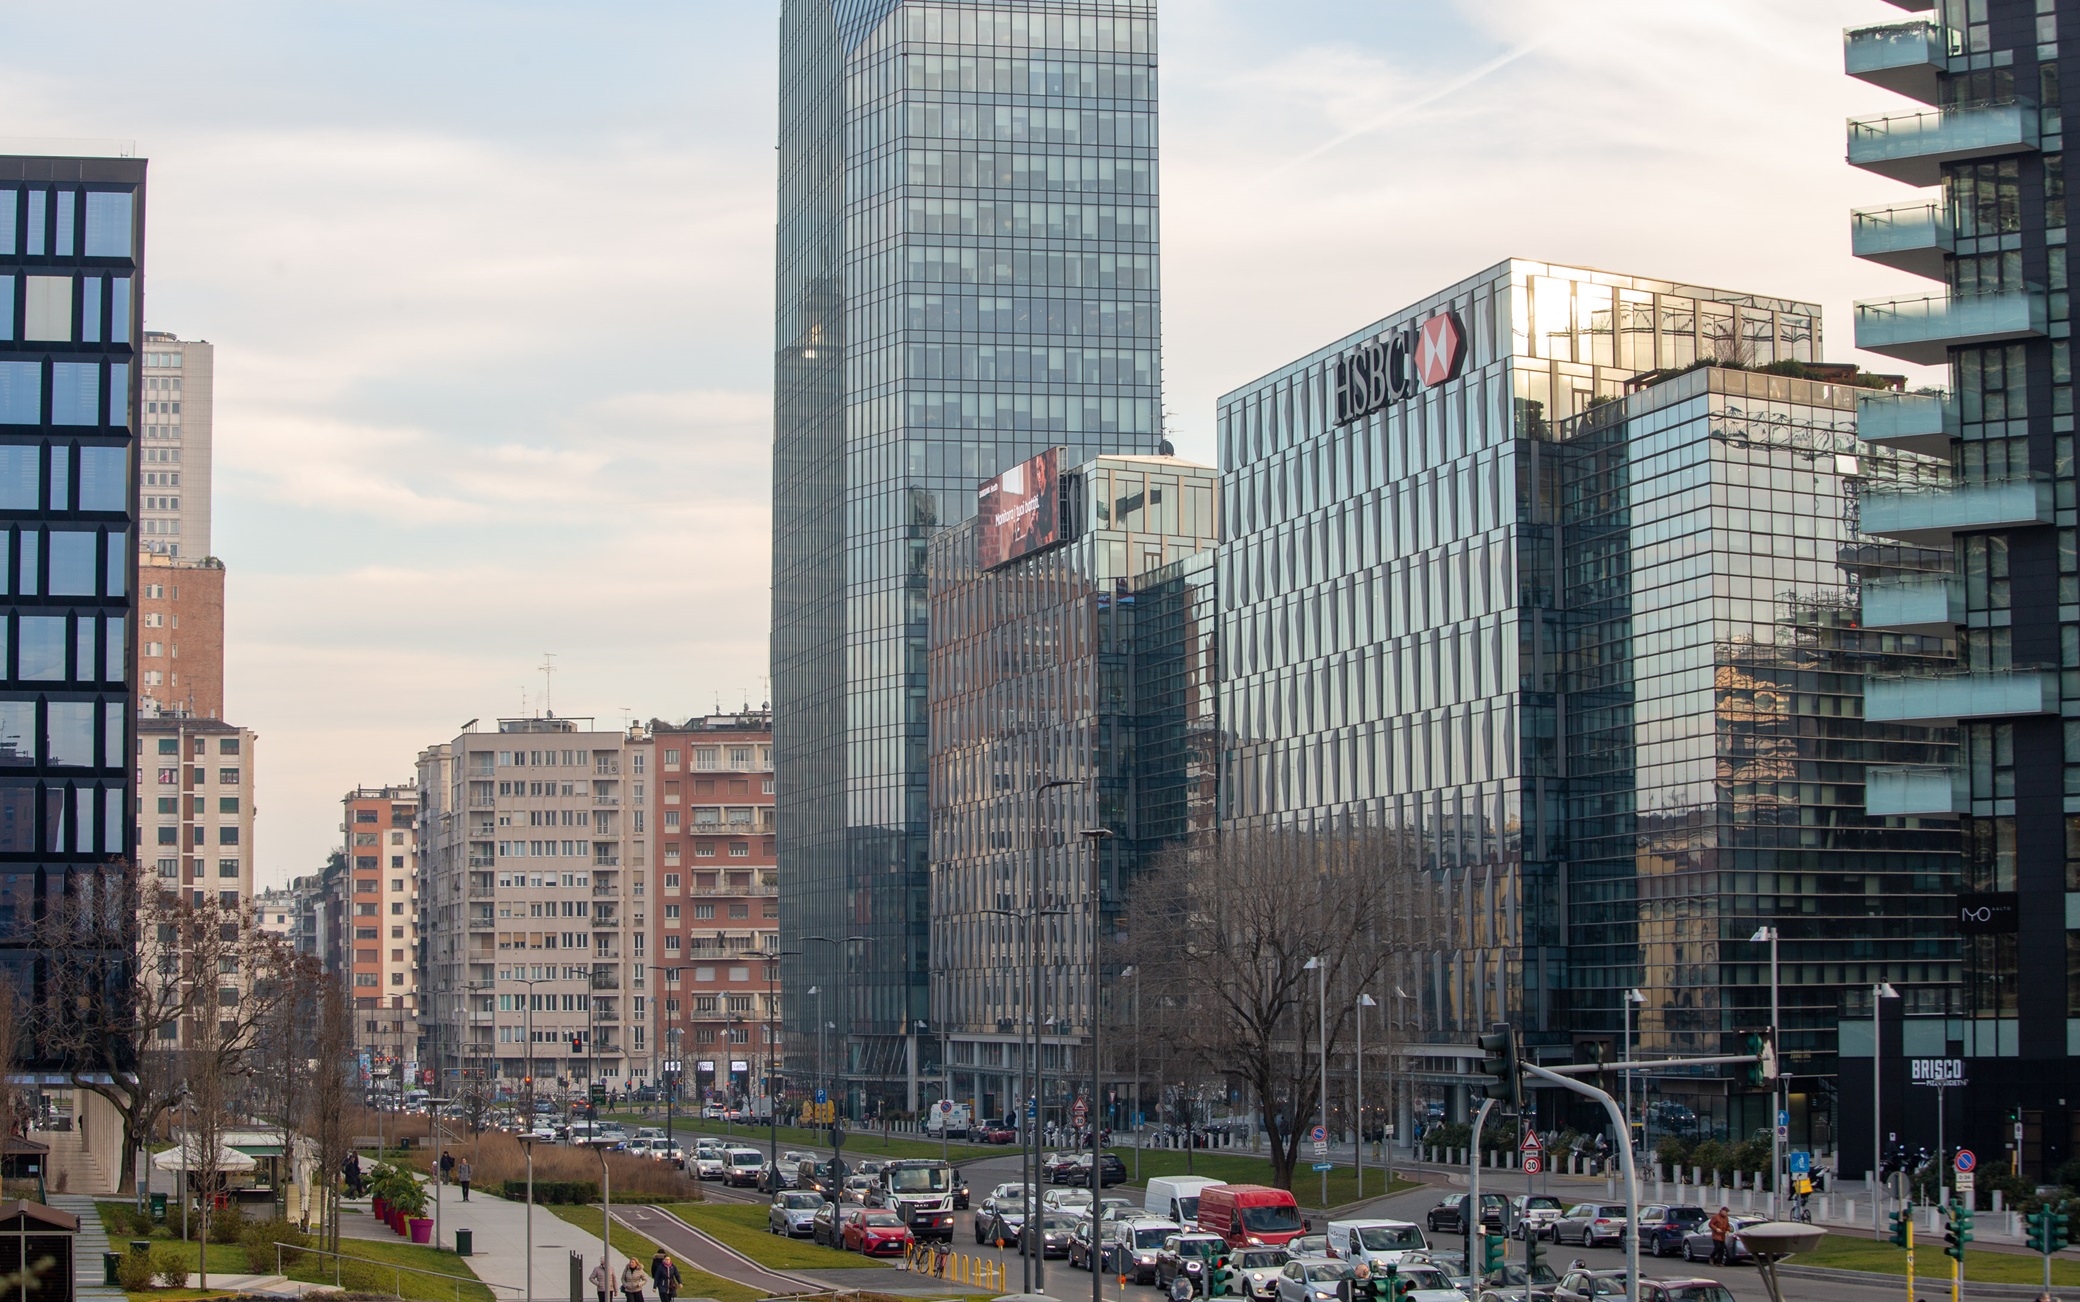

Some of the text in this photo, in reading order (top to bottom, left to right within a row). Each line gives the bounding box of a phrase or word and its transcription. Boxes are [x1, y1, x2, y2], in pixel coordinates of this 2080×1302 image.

[1331, 331, 1406, 425] HSBC
[1911, 1059, 1962, 1079] BRISCO
[818, 1089, 824, 1097] P
[1527, 1161, 1536, 1170] 30
